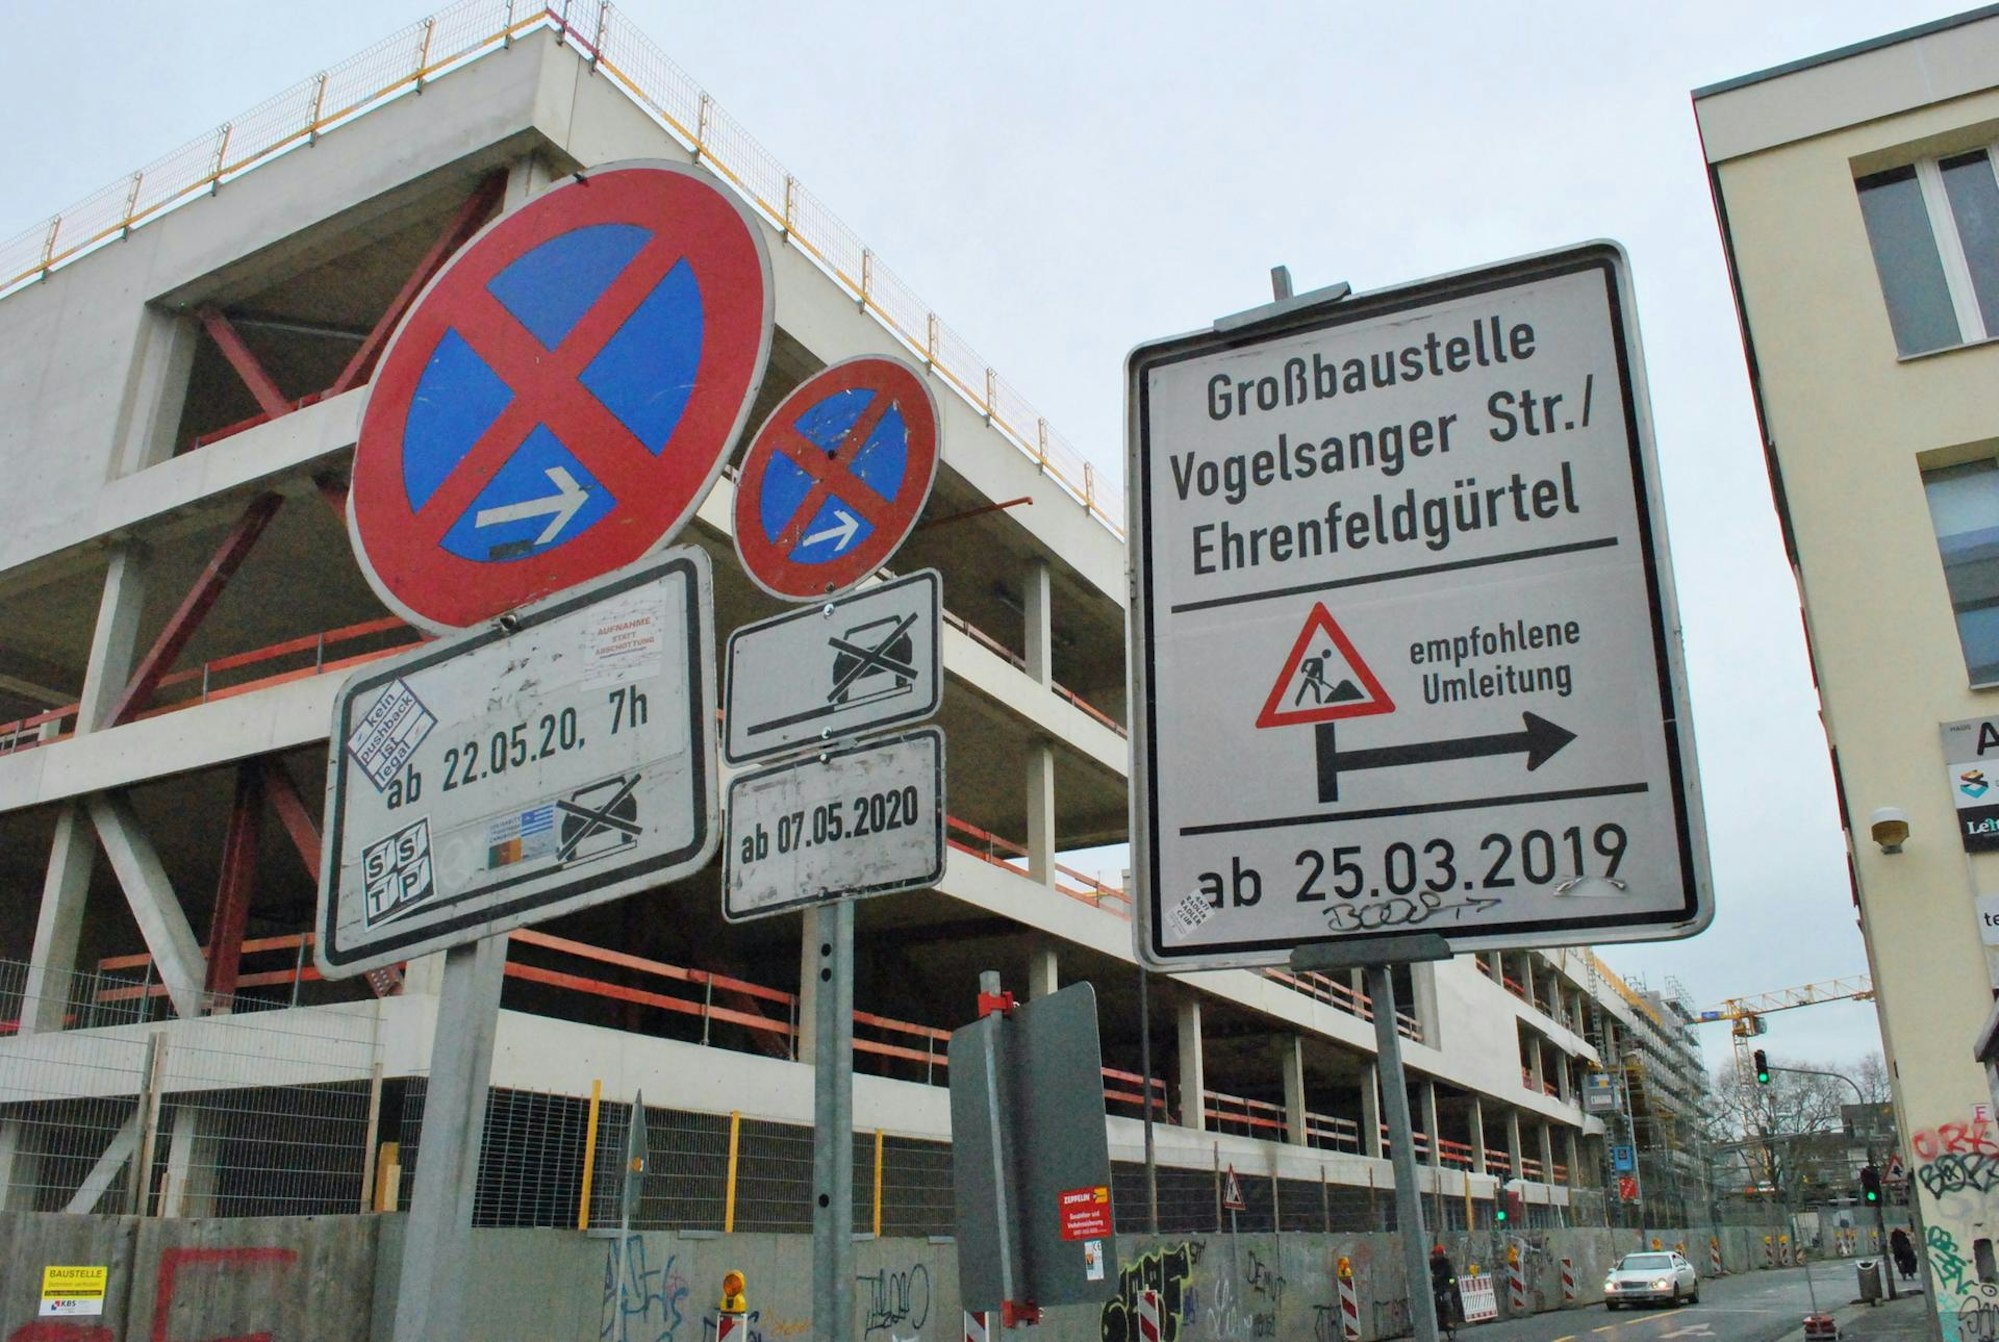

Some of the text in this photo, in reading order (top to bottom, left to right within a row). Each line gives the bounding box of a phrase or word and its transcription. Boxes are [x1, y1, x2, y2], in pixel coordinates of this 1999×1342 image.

[1207, 315, 1536, 421] Großbaustelle
[1170, 374, 1593, 505] Vogelsanger Str./
[1192, 460, 1580, 576] Ehrenfeldgürtel
[597, 616, 652, 636] AUFNAHME
[1409, 619, 1580, 671] empfohlene
[1423, 662, 1573, 705] Umleitung
[360, 696, 413, 765] pushback
[366, 693, 395, 728] kein
[376, 740, 411, 781] legal
[380, 737, 400, 760] ist
[386, 684, 649, 810] ab 22.05.20, 7h
[1977, 721, 1999, 756] A
[741, 785, 919, 865] ab 07.05.2020
[1197, 822, 1628, 909] ab 25.03.2019
[50, 1269, 102, 1278] BAUSTELLE
